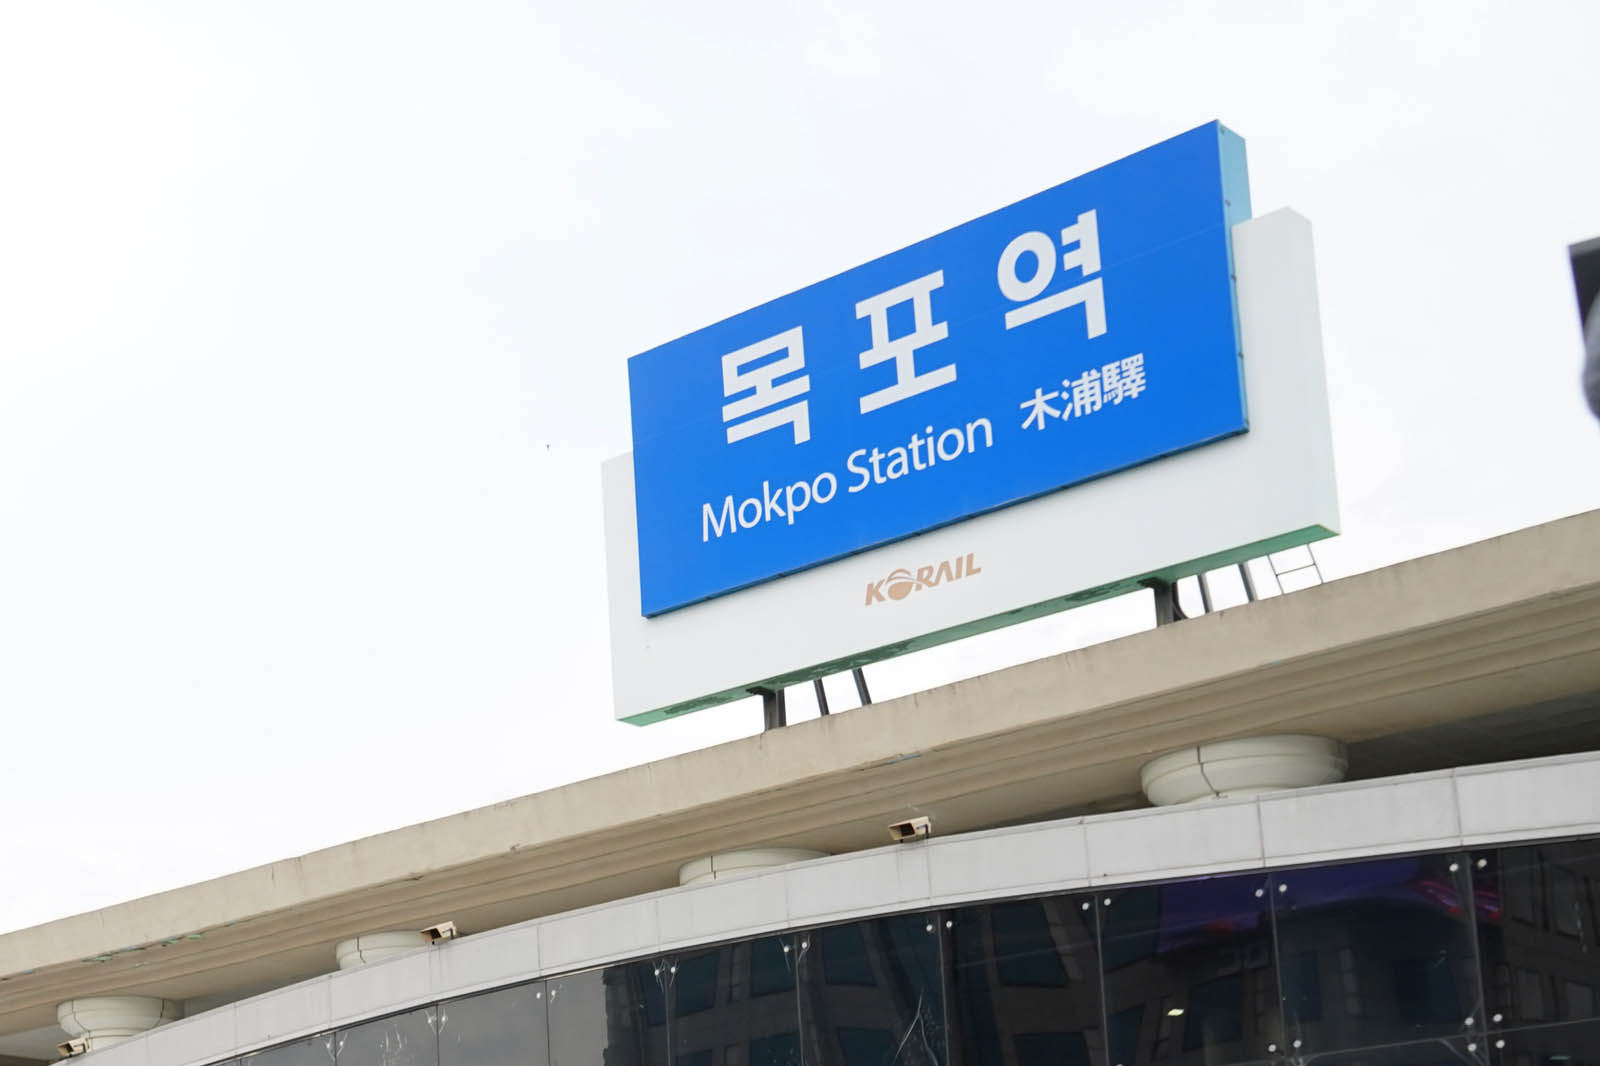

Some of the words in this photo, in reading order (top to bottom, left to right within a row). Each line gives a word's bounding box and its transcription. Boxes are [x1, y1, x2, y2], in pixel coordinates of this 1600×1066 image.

[701, 472, 838, 543] Mokpo
[846, 416, 994, 494] Station
[1018, 352, 1148, 432] 木浦驛
[864, 551, 982, 607] KORAIL
